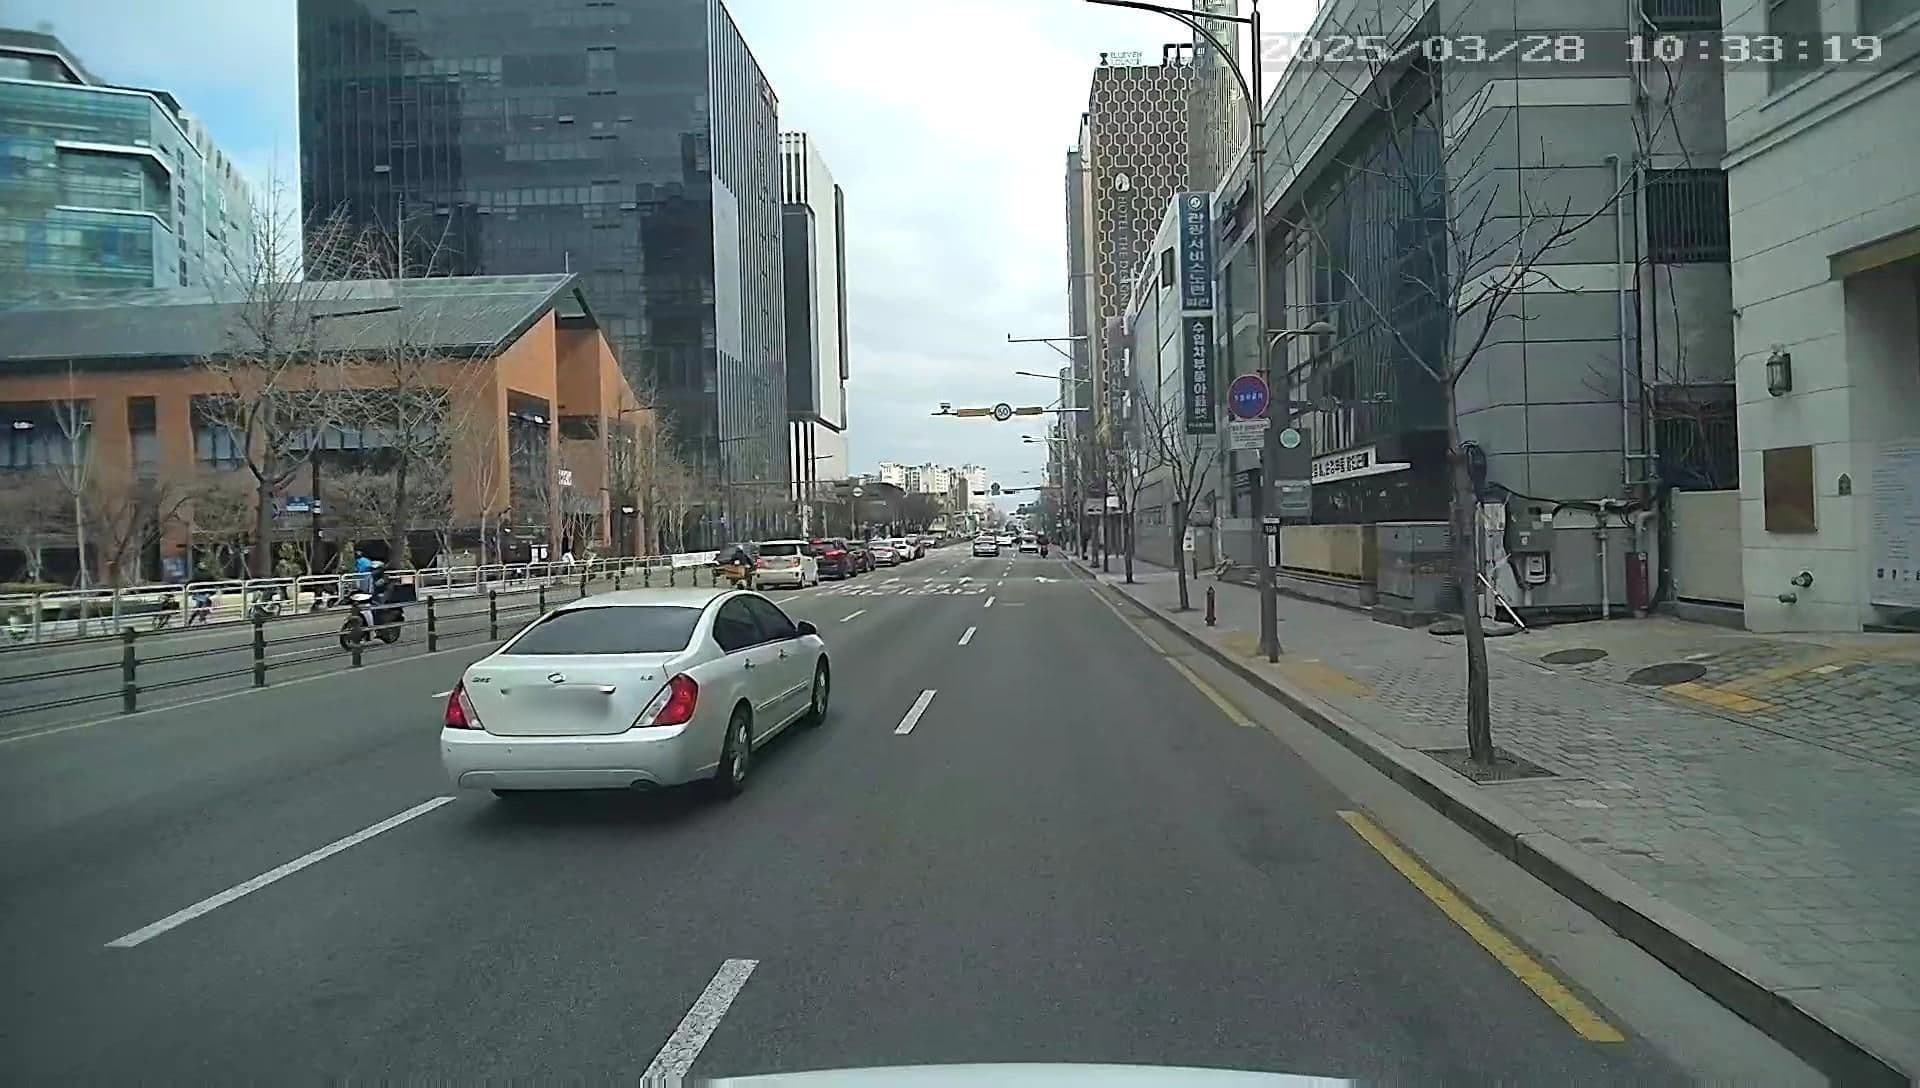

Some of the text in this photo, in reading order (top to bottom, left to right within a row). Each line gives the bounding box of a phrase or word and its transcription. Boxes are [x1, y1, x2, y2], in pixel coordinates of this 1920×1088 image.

[1118, 196, 1128, 230] HOTEL
[1119, 236, 1129, 258] THE
[997, 407, 1009, 416] 50
